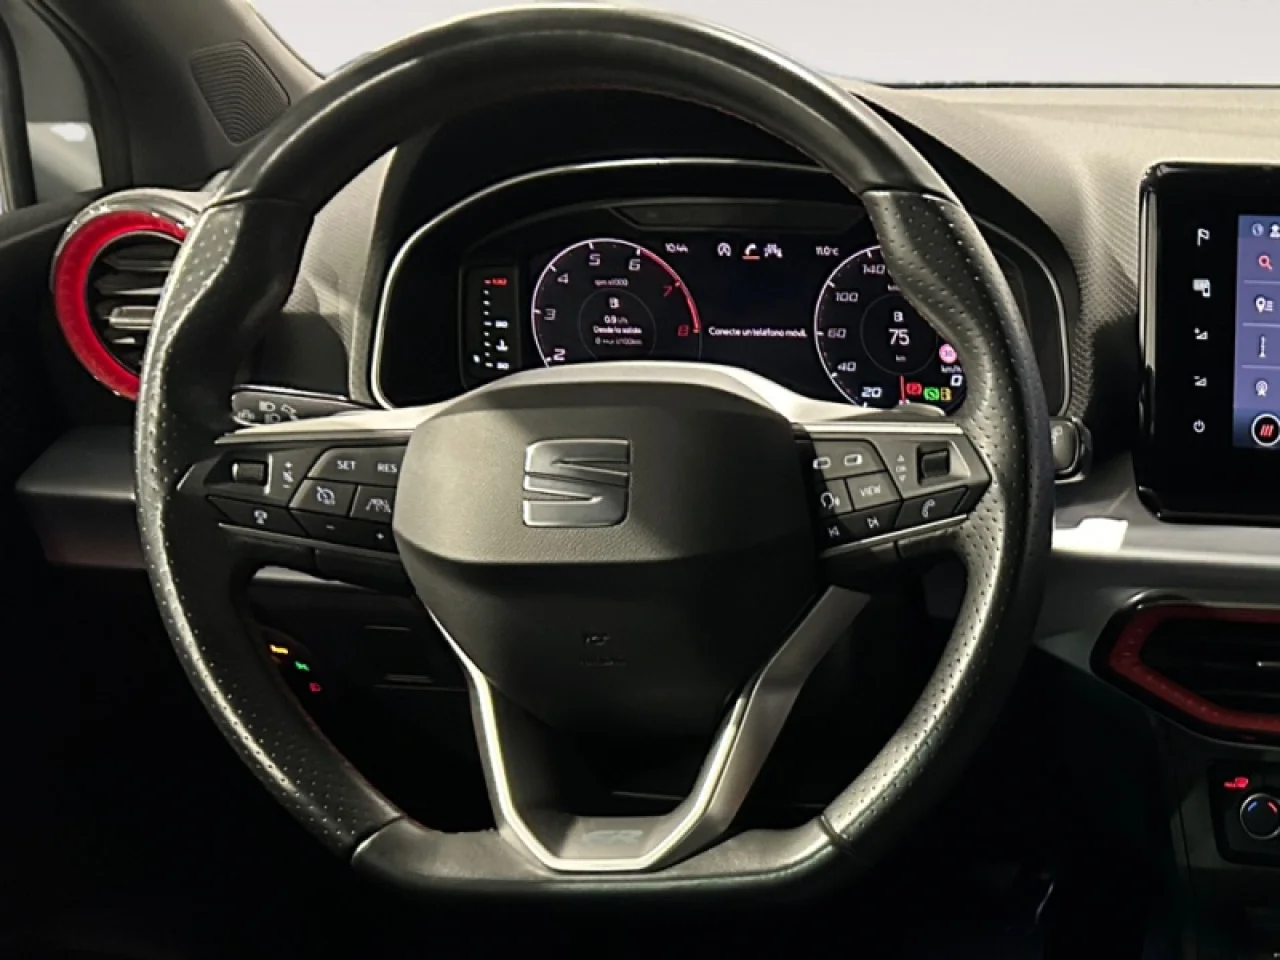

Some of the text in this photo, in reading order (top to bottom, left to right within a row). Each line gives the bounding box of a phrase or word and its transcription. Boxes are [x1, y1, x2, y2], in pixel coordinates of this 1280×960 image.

[588, 253, 601, 266] 5
[628, 258, 641, 271] 6
[862, 264, 886, 275] 140
[556, 273, 569, 284] 4
[835, 292, 859, 302] 100
[544, 308, 556, 320] 3
[677, 325, 689, 337] 8
[888, 328, 910, 345] 75
[553, 348, 566, 361] 2
[837, 361, 857, 372] 40
[861, 386, 883, 398] 20
[336, 460, 357, 471] SET
[377, 463, 398, 473] RES
[859, 484, 882, 497] VIEW
